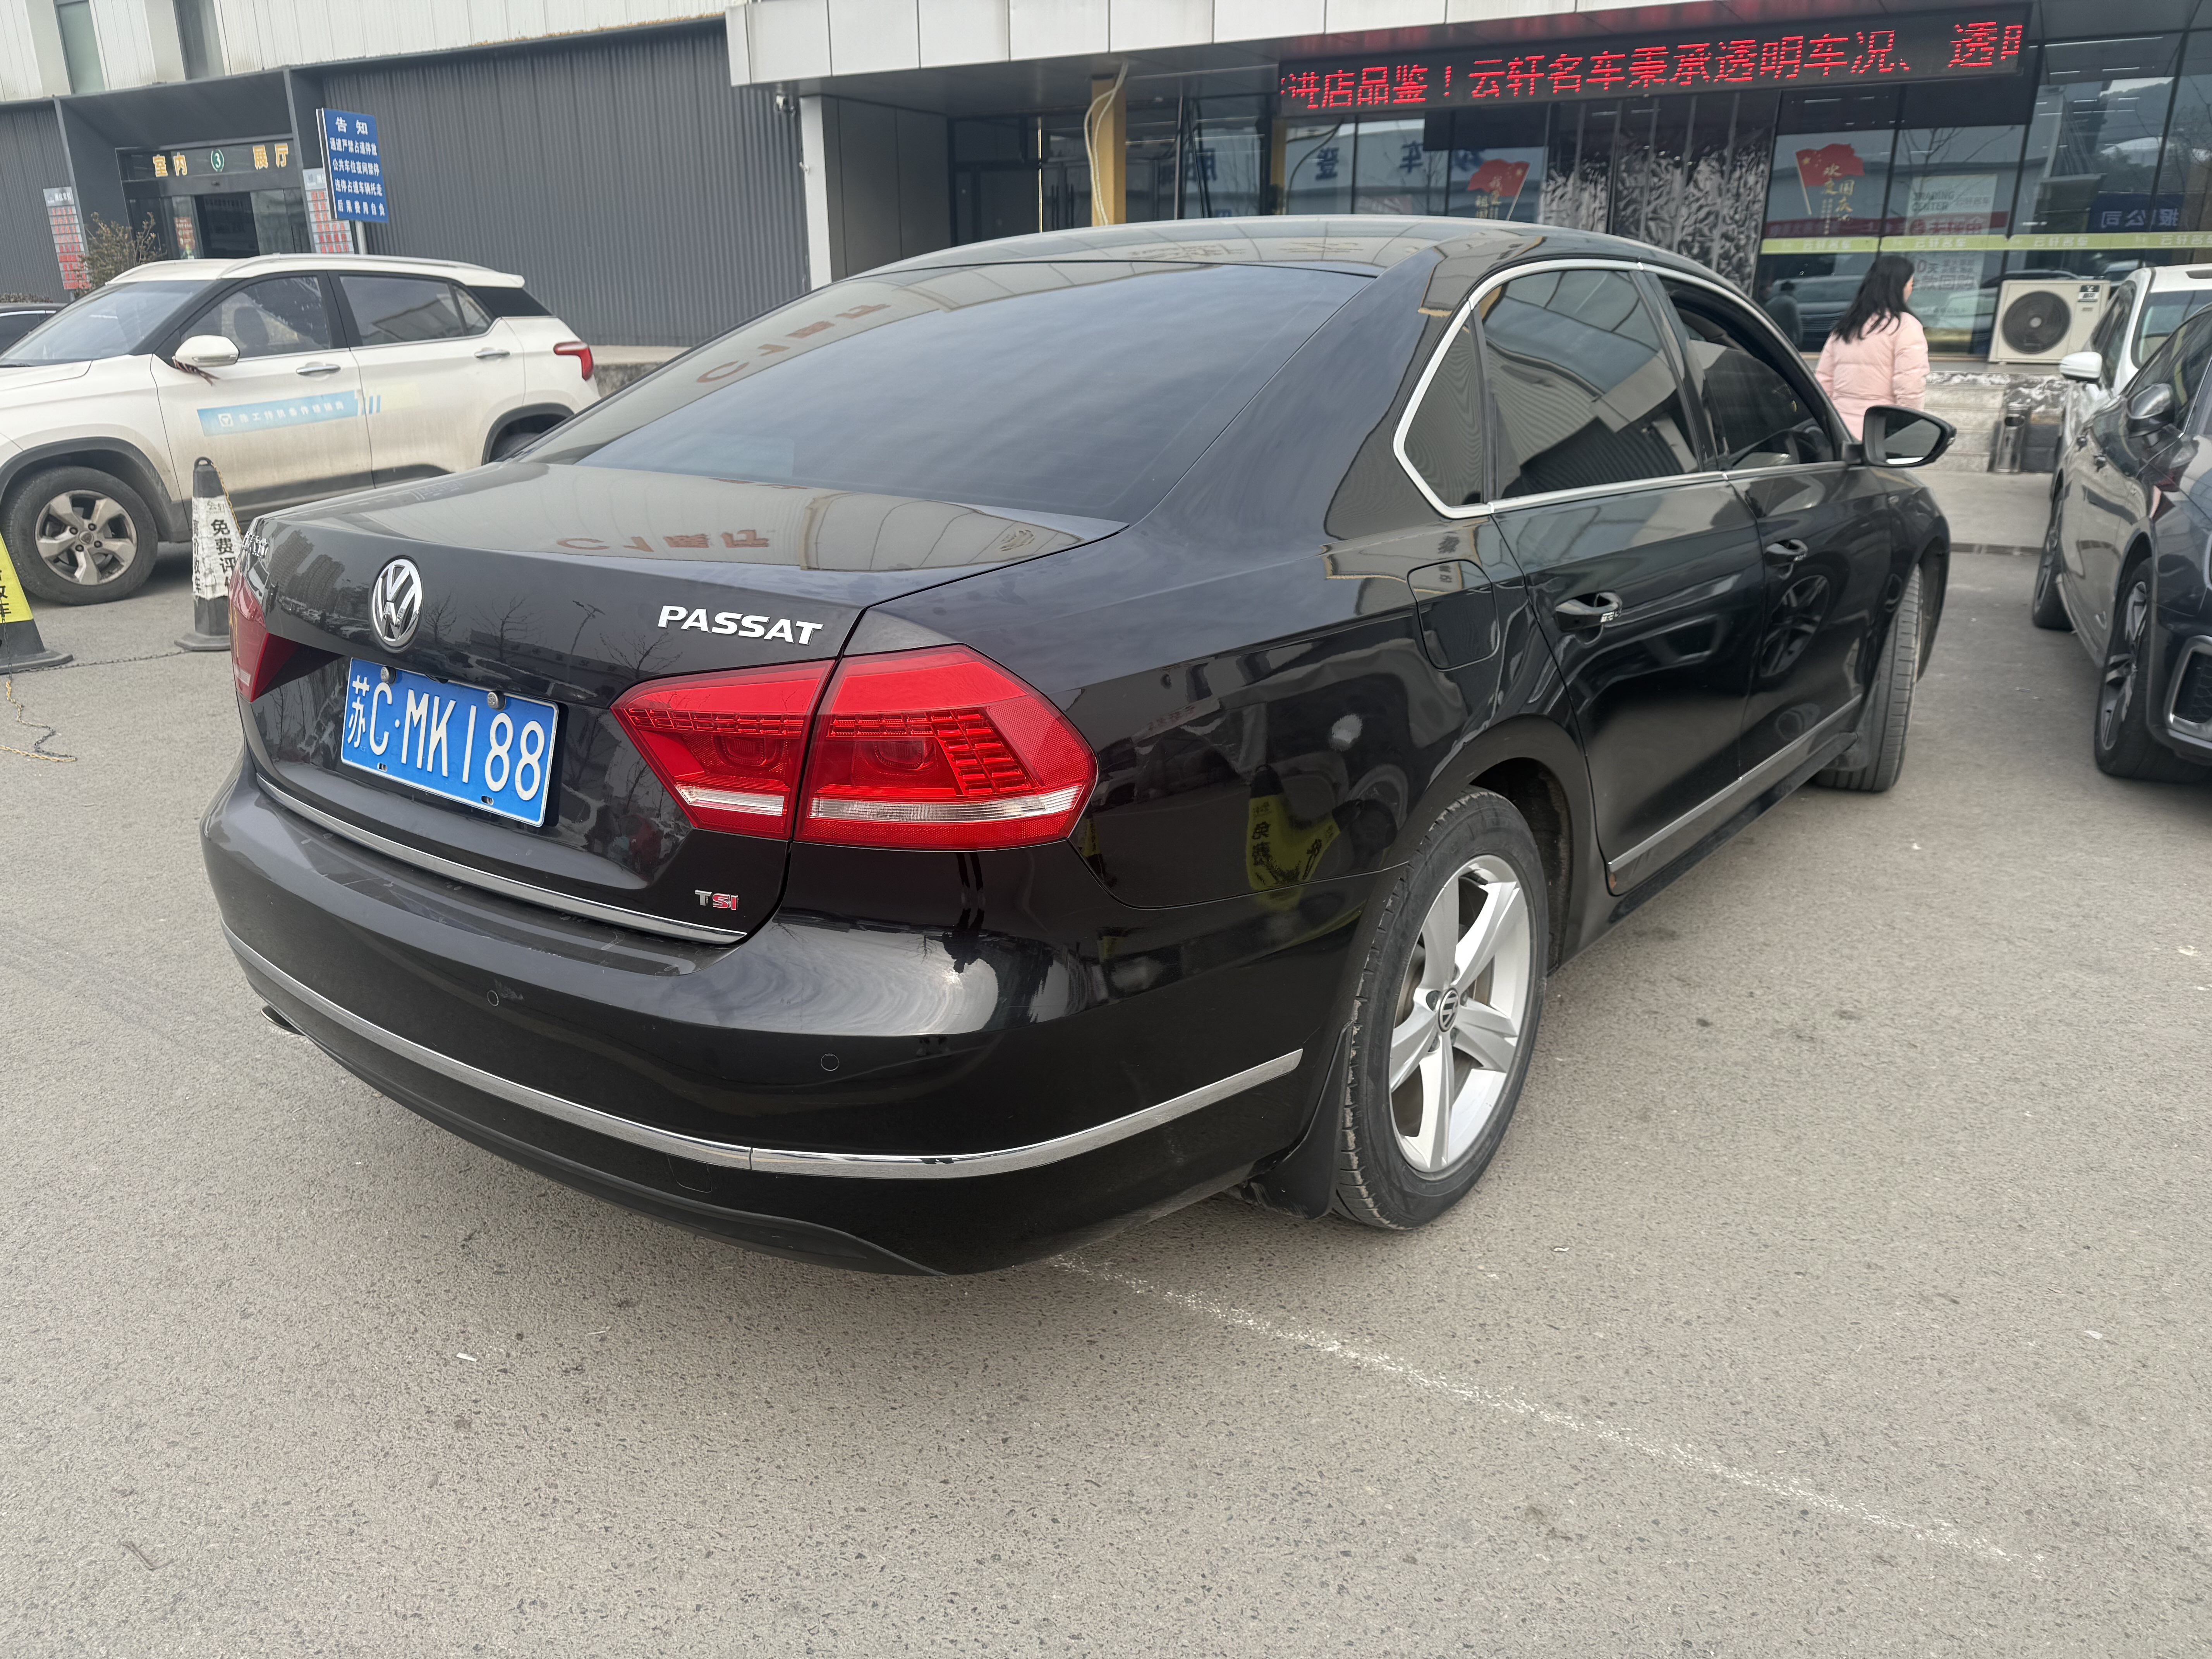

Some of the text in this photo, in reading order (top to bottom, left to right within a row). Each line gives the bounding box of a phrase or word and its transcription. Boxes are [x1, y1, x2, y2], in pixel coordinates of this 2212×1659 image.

[335, 117, 368, 135] 告知
[153, 152, 187, 177] 室内
[252, 143, 289, 170] 展厅
[333, 158, 380, 176] 公共车位夜间禁停
[338, 199, 385, 216] 后果费用自负
[658, 605, 824, 646] PASSAT
[347, 675, 544, 801] 苏C·MK188
[695, 889, 738, 910] TSI
